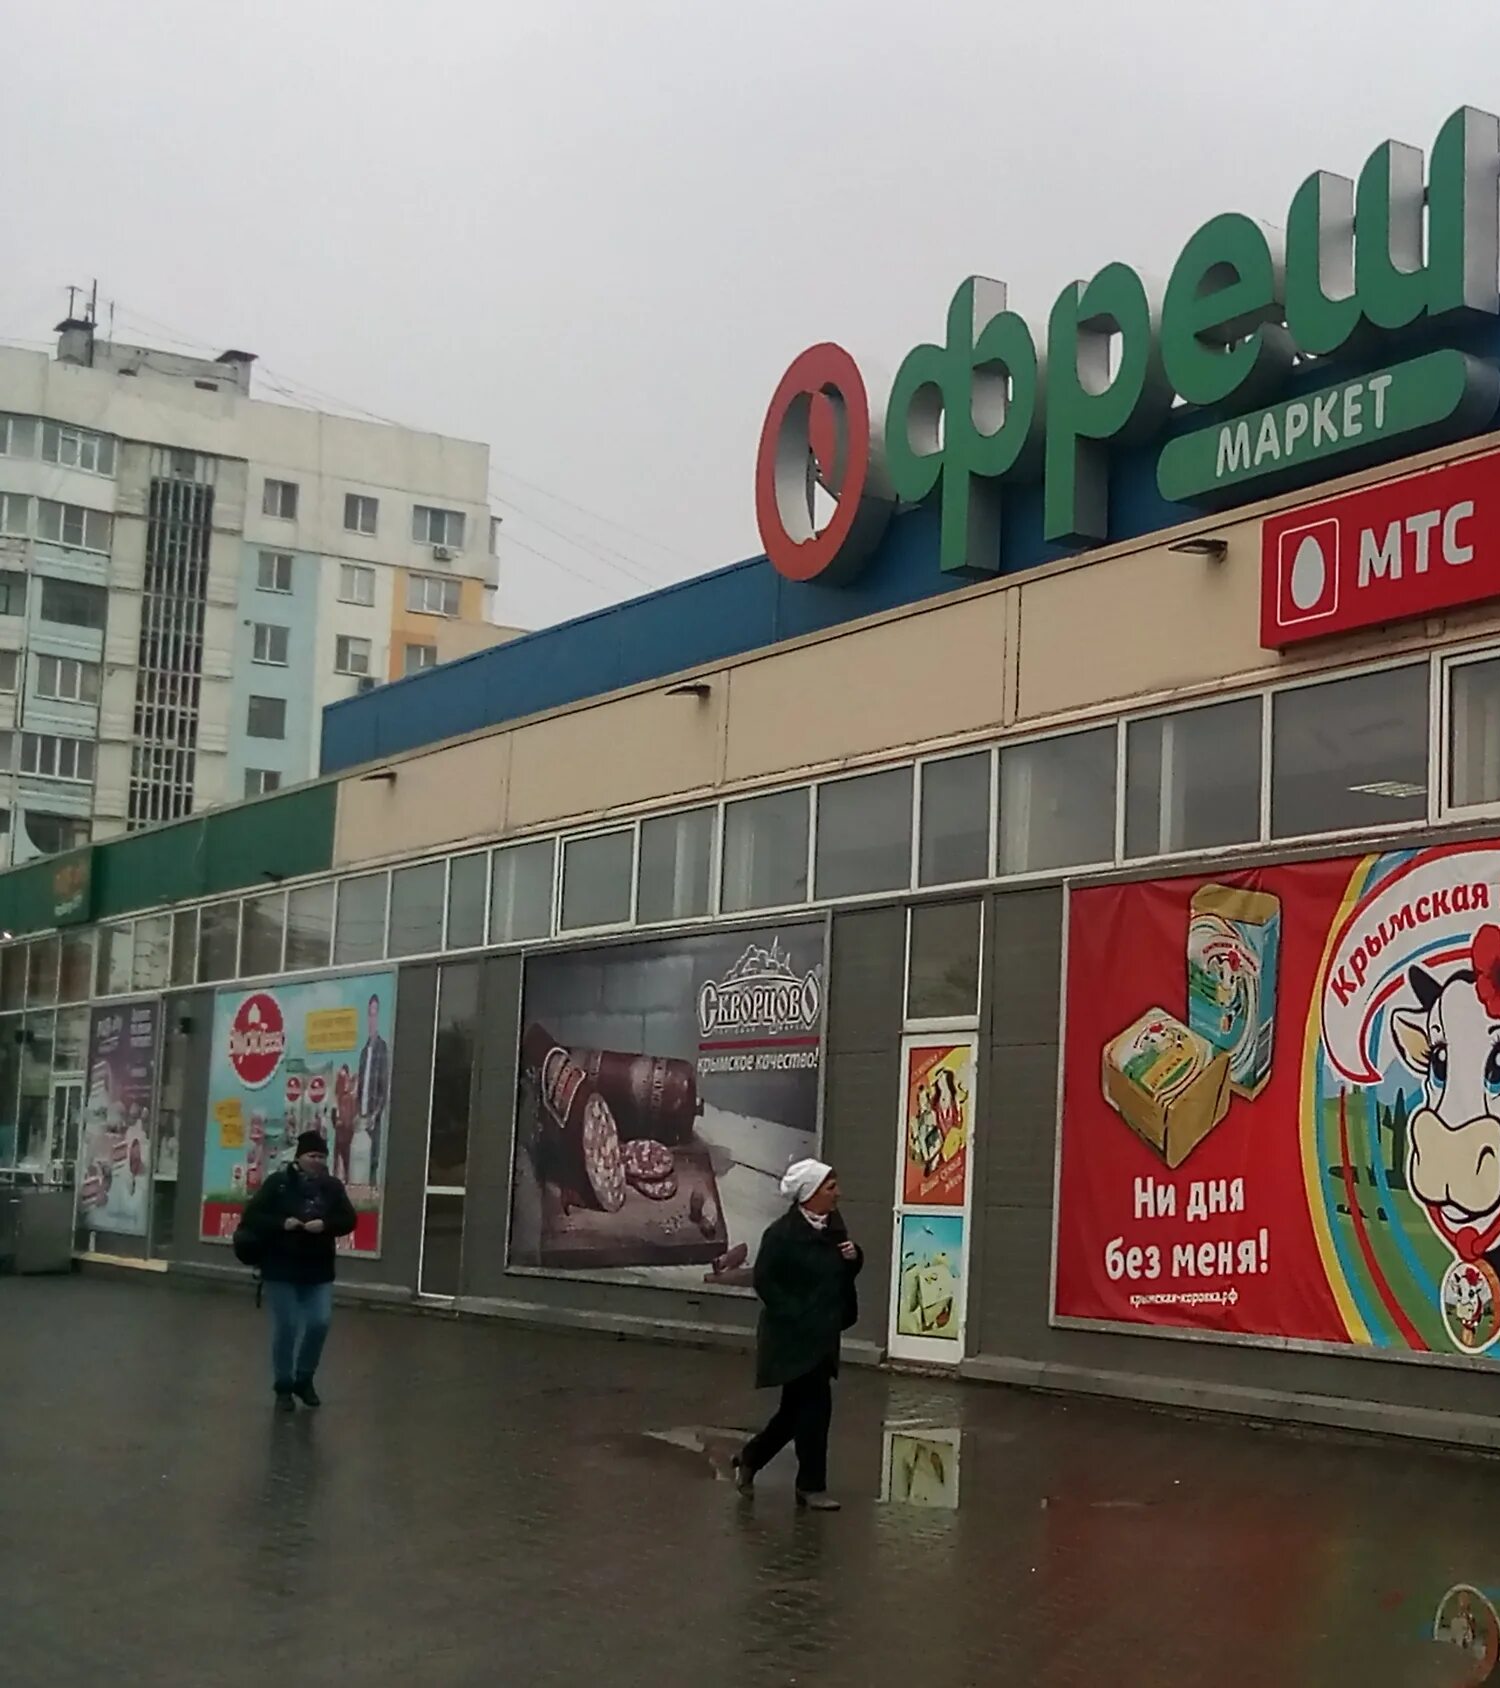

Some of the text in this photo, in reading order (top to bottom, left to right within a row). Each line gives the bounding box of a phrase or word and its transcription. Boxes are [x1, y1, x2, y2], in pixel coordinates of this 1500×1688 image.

[1214, 373, 1393, 478] МАРКЕТ
[1356, 501, 1475, 588] МТС
[1330, 882, 1490, 1007] Крымская
[1134, 1176, 1245, 1222] Ни дня
[1105, 1228, 1268, 1280] без меня!
